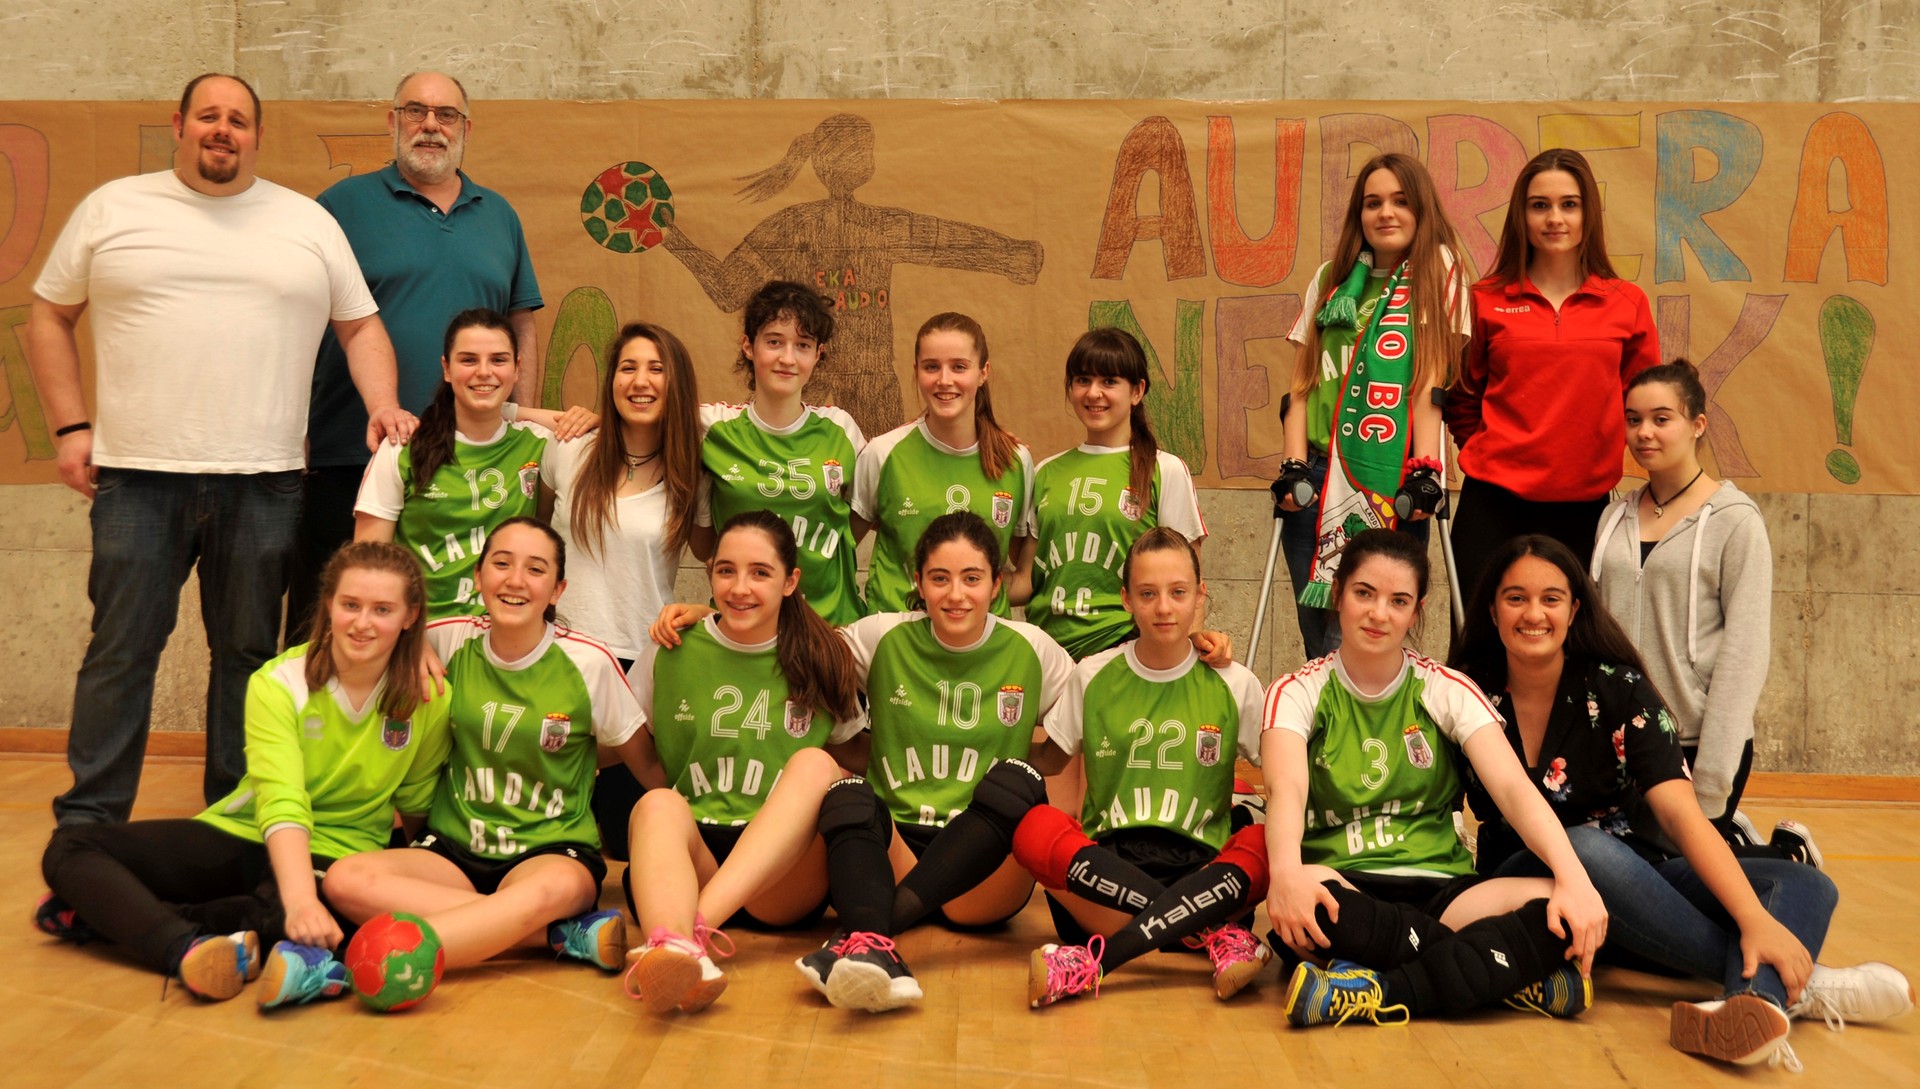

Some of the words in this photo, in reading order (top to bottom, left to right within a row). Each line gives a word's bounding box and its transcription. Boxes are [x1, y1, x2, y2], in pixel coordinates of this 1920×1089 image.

[835, 289, 888, 311] AUDIO
[1358, 381, 1403, 444] BC
[463, 468, 508, 511] 13
[757, 458, 816, 500] 35
[946, 484, 971, 515] 8
[1067, 477, 1108, 516] 15
[711, 685, 772, 740] 24
[936, 680, 982, 730] 10
[481, 701, 526, 753] 17
[1126, 718, 1186, 770] 22
[828, 778, 864, 791] empa
[1006, 757, 1042, 782] Kempa
[1361, 738, 1389, 790] 3
[470, 819, 527, 855] B.C.
[1345, 815, 1404, 855] B.C.
[1068, 860, 1153, 910] alenji
[1139, 872, 1241, 940] Kalenji
